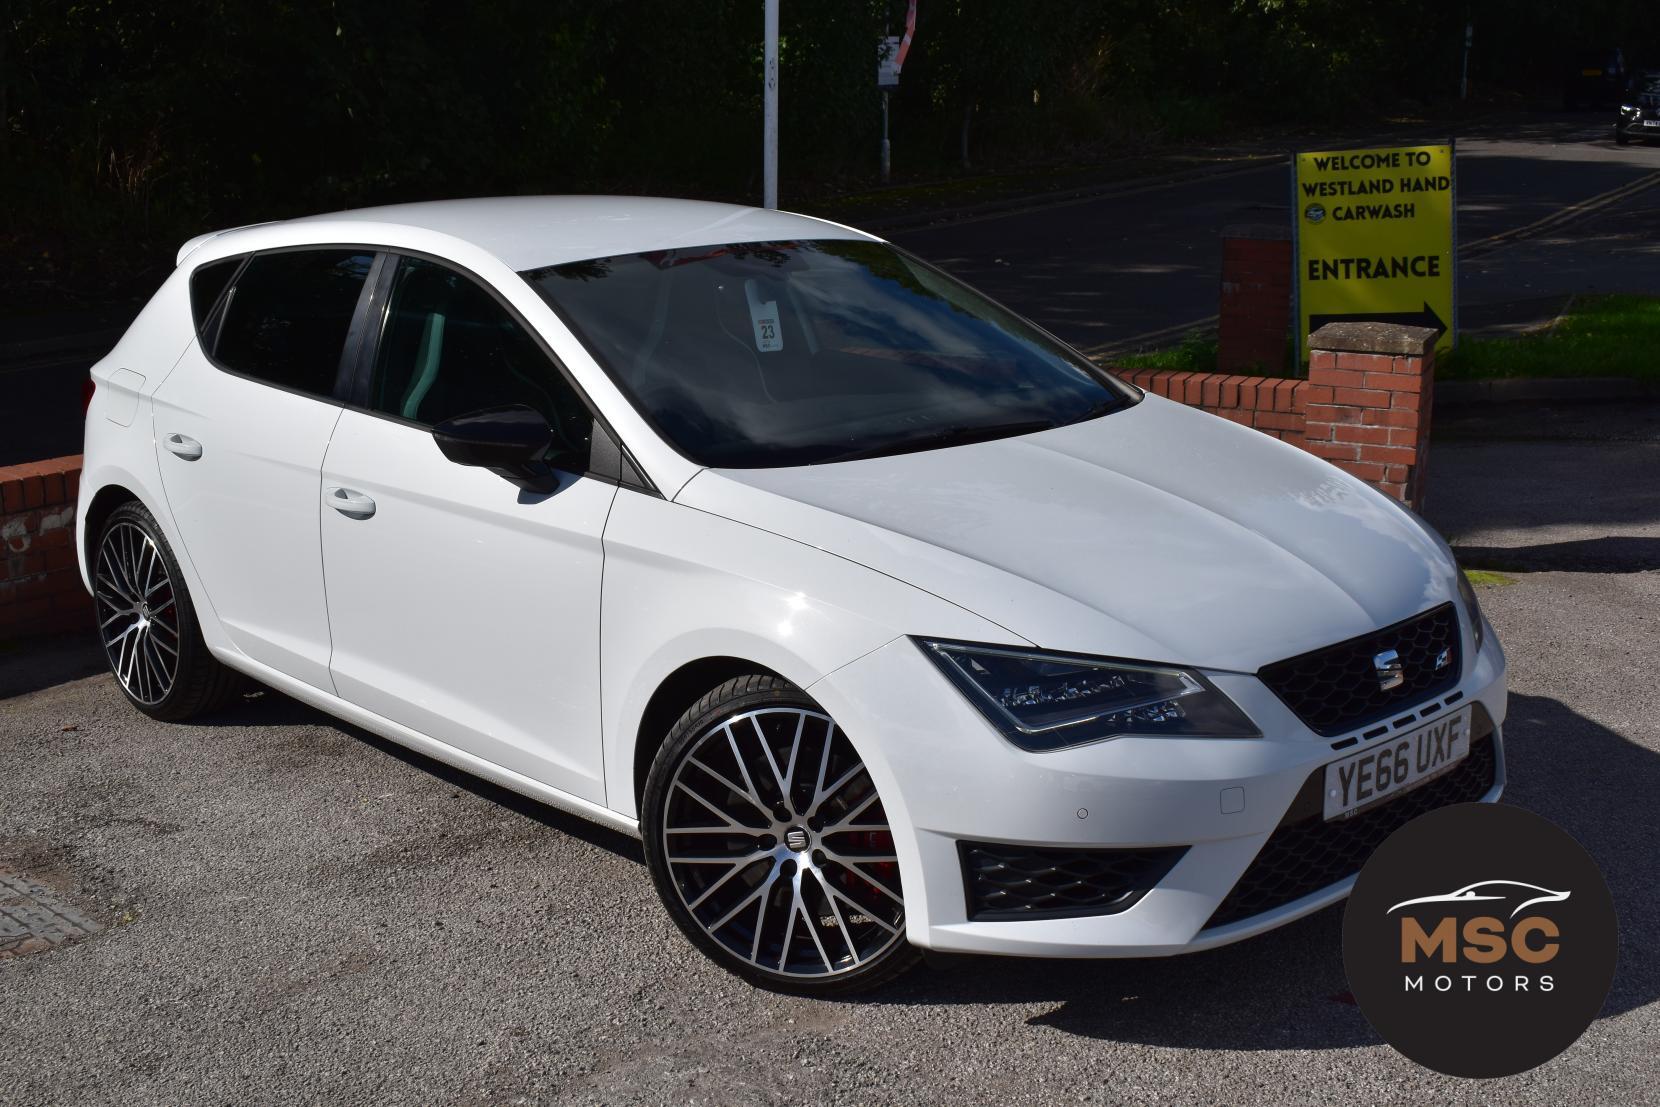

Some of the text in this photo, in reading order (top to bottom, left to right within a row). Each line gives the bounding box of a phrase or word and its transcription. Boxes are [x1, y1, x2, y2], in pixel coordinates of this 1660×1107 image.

[1314, 152, 1431, 171] WELCOME TO
[1302, 176, 1450, 197] WESTLAND HAND
[1332, 203, 1415, 221] CARWASH
[1308, 256, 1440, 280] ENTRANCE
[761, 325, 775, 339] 23
[1338, 715, 1462, 807] YE66 UXF
